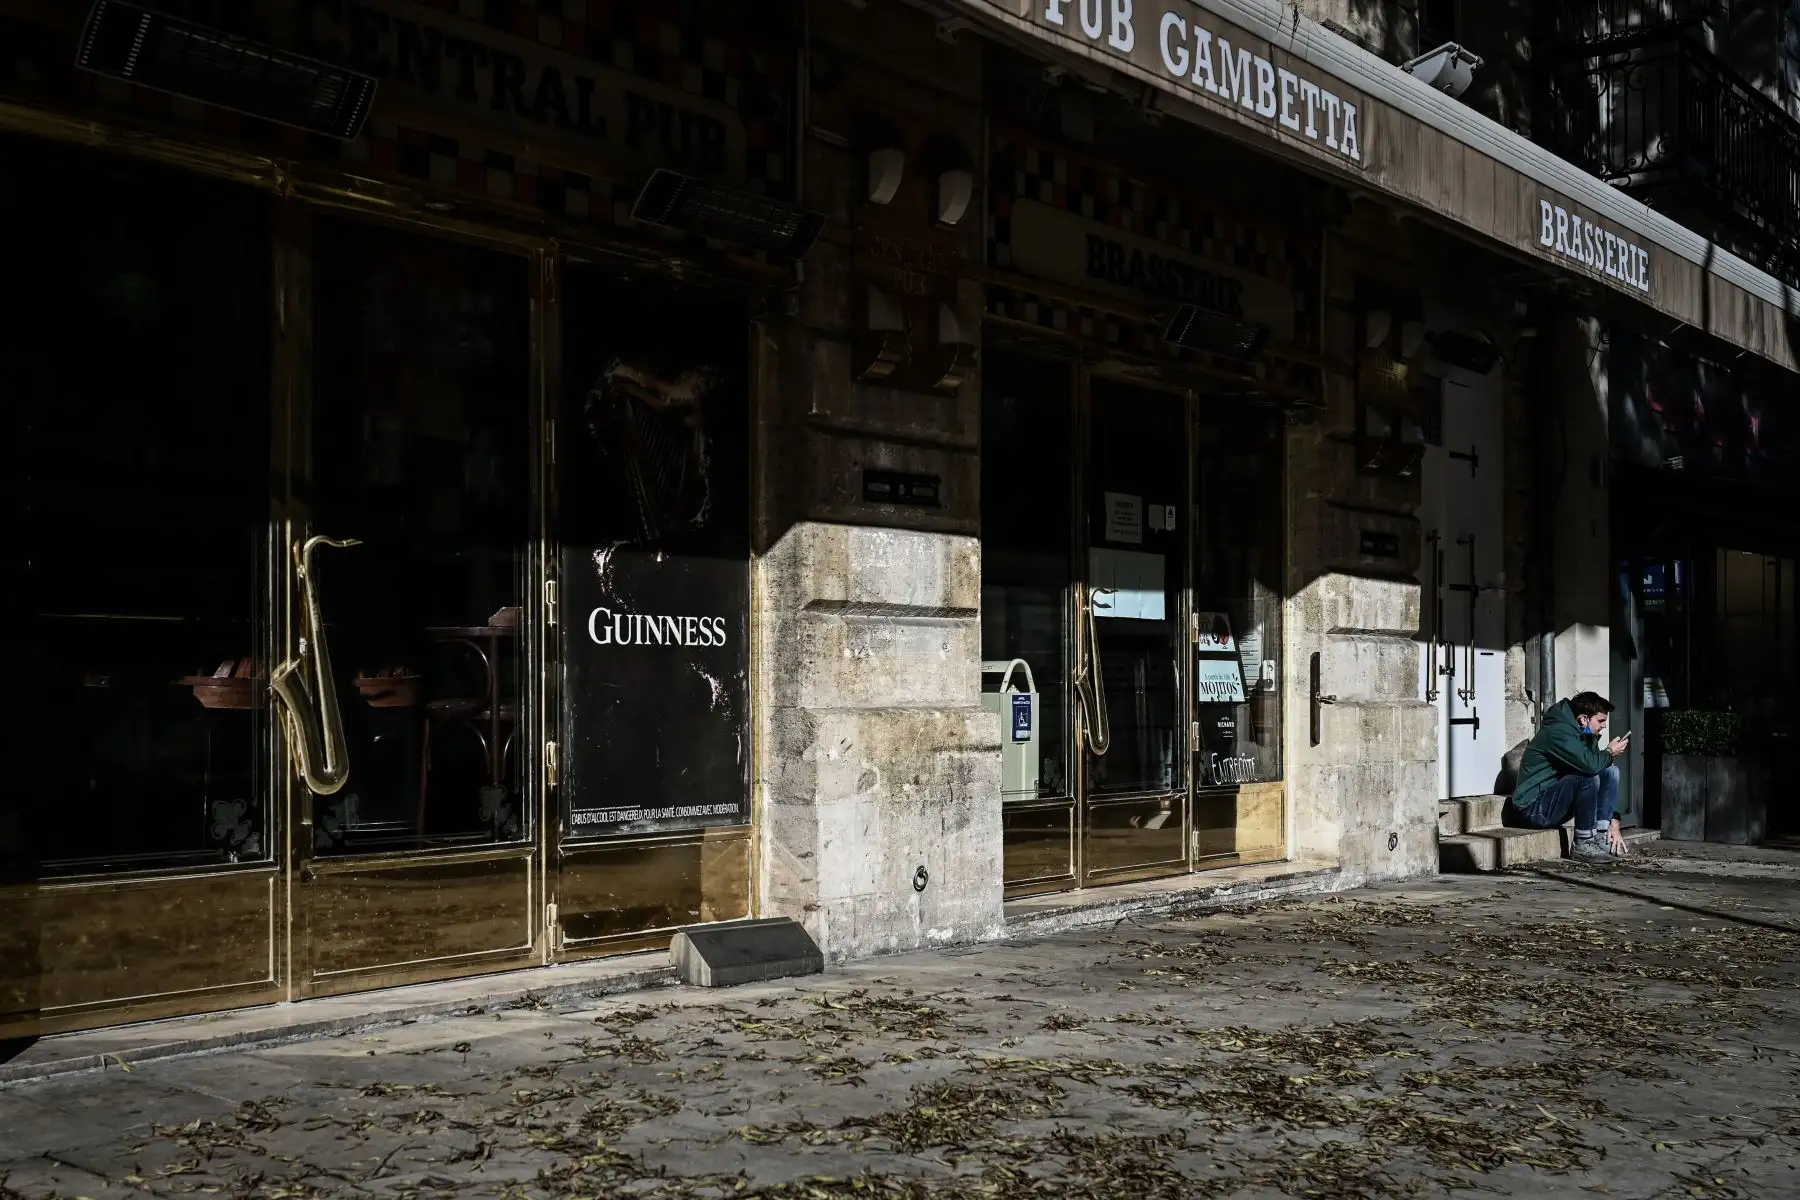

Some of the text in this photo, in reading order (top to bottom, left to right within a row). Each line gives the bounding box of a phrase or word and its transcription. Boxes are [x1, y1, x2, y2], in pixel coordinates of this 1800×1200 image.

[1159, 11, 1361, 161] GAMBETTA
[622, 90, 728, 171] PUB
[1085, 233, 1243, 316] BRASSERIE
[1540, 199, 1649, 293] BRASSERIE
[588, 606, 727, 647] GUINNESS
[1200, 681, 1238, 697] MOJITOS
